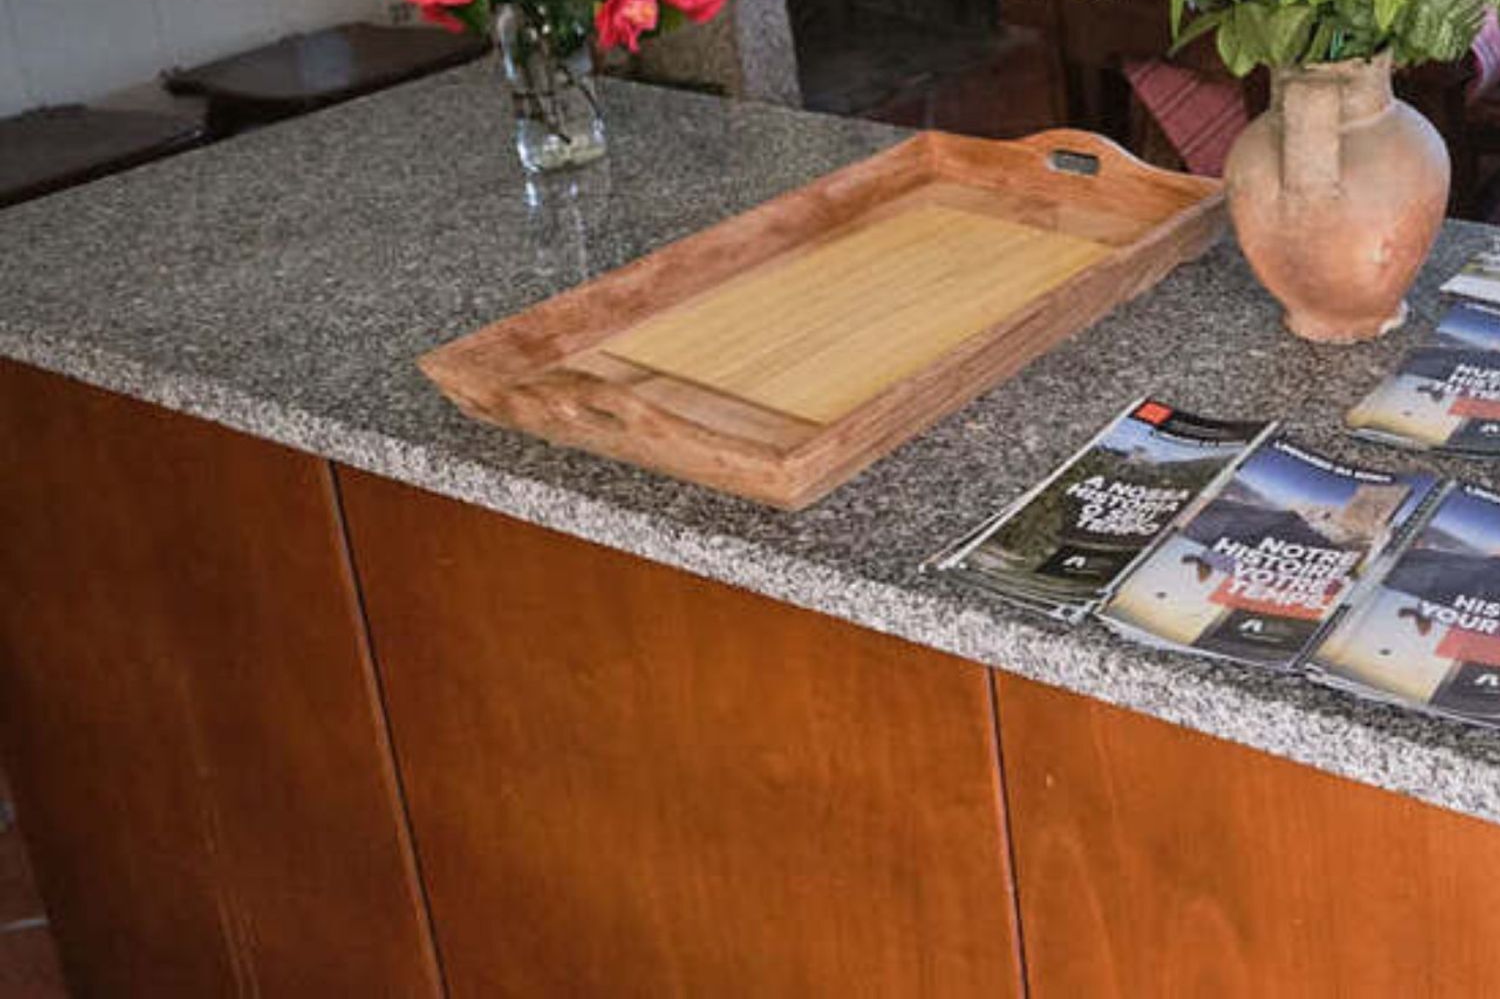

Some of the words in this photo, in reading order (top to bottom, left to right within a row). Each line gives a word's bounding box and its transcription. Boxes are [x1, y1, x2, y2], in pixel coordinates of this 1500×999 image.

[1084, 475, 1105, 490] A
[1108, 482, 1191, 502] NOSSA
[1257, 537, 1361, 567] NOTRE
[1420, 601, 1500, 636] YOUR
